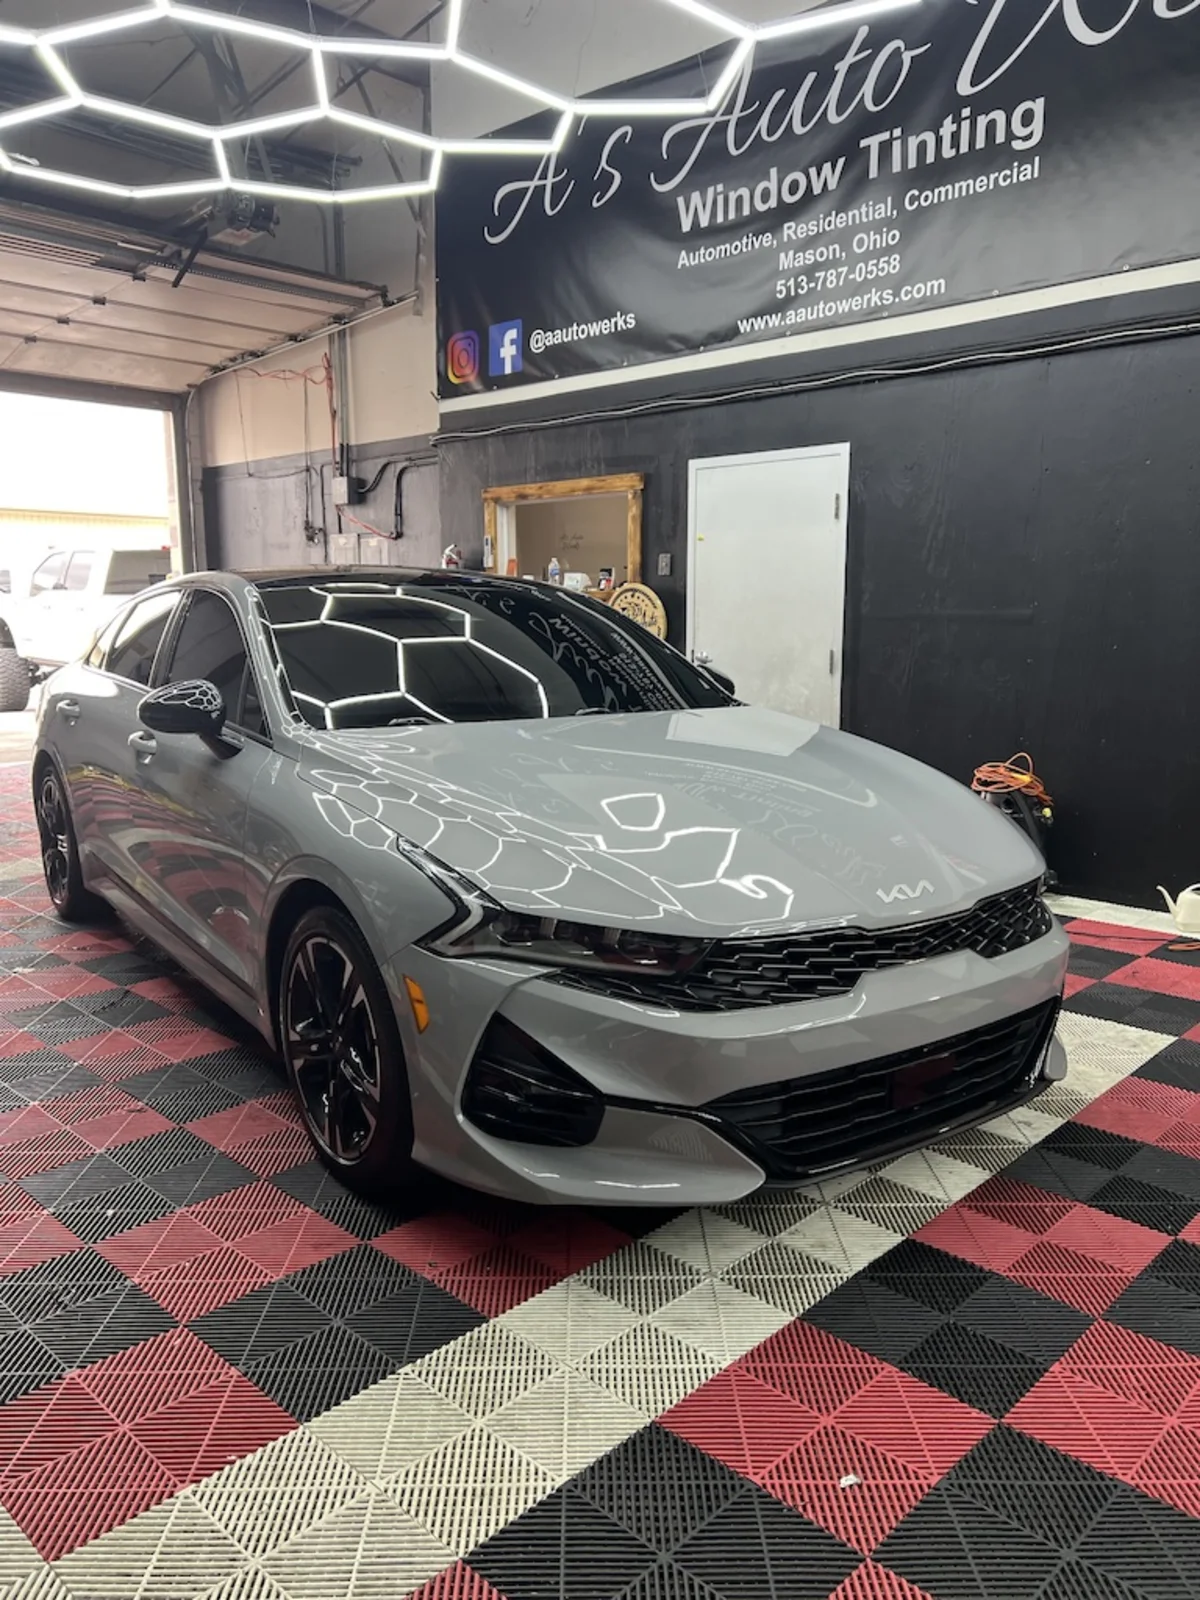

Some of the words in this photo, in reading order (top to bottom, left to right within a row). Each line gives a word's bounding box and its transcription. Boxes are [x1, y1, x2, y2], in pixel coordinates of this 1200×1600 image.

[650, 25, 932, 192] Auto
[676, 156, 846, 234] Window
[859, 96, 1046, 180] Tinting
[677, 232, 778, 269] Automotive,
[783, 196, 898, 244] Residential,
[904, 156, 1040, 211] Commercial
[775, 254, 901, 299] 513-787-0558
[779, 241, 847, 271] Mason,
[852, 228, 901, 254] Ohio
[529, 311, 636, 353] @aautowerks
[737, 276, 946, 334] www.aautowerks.com
